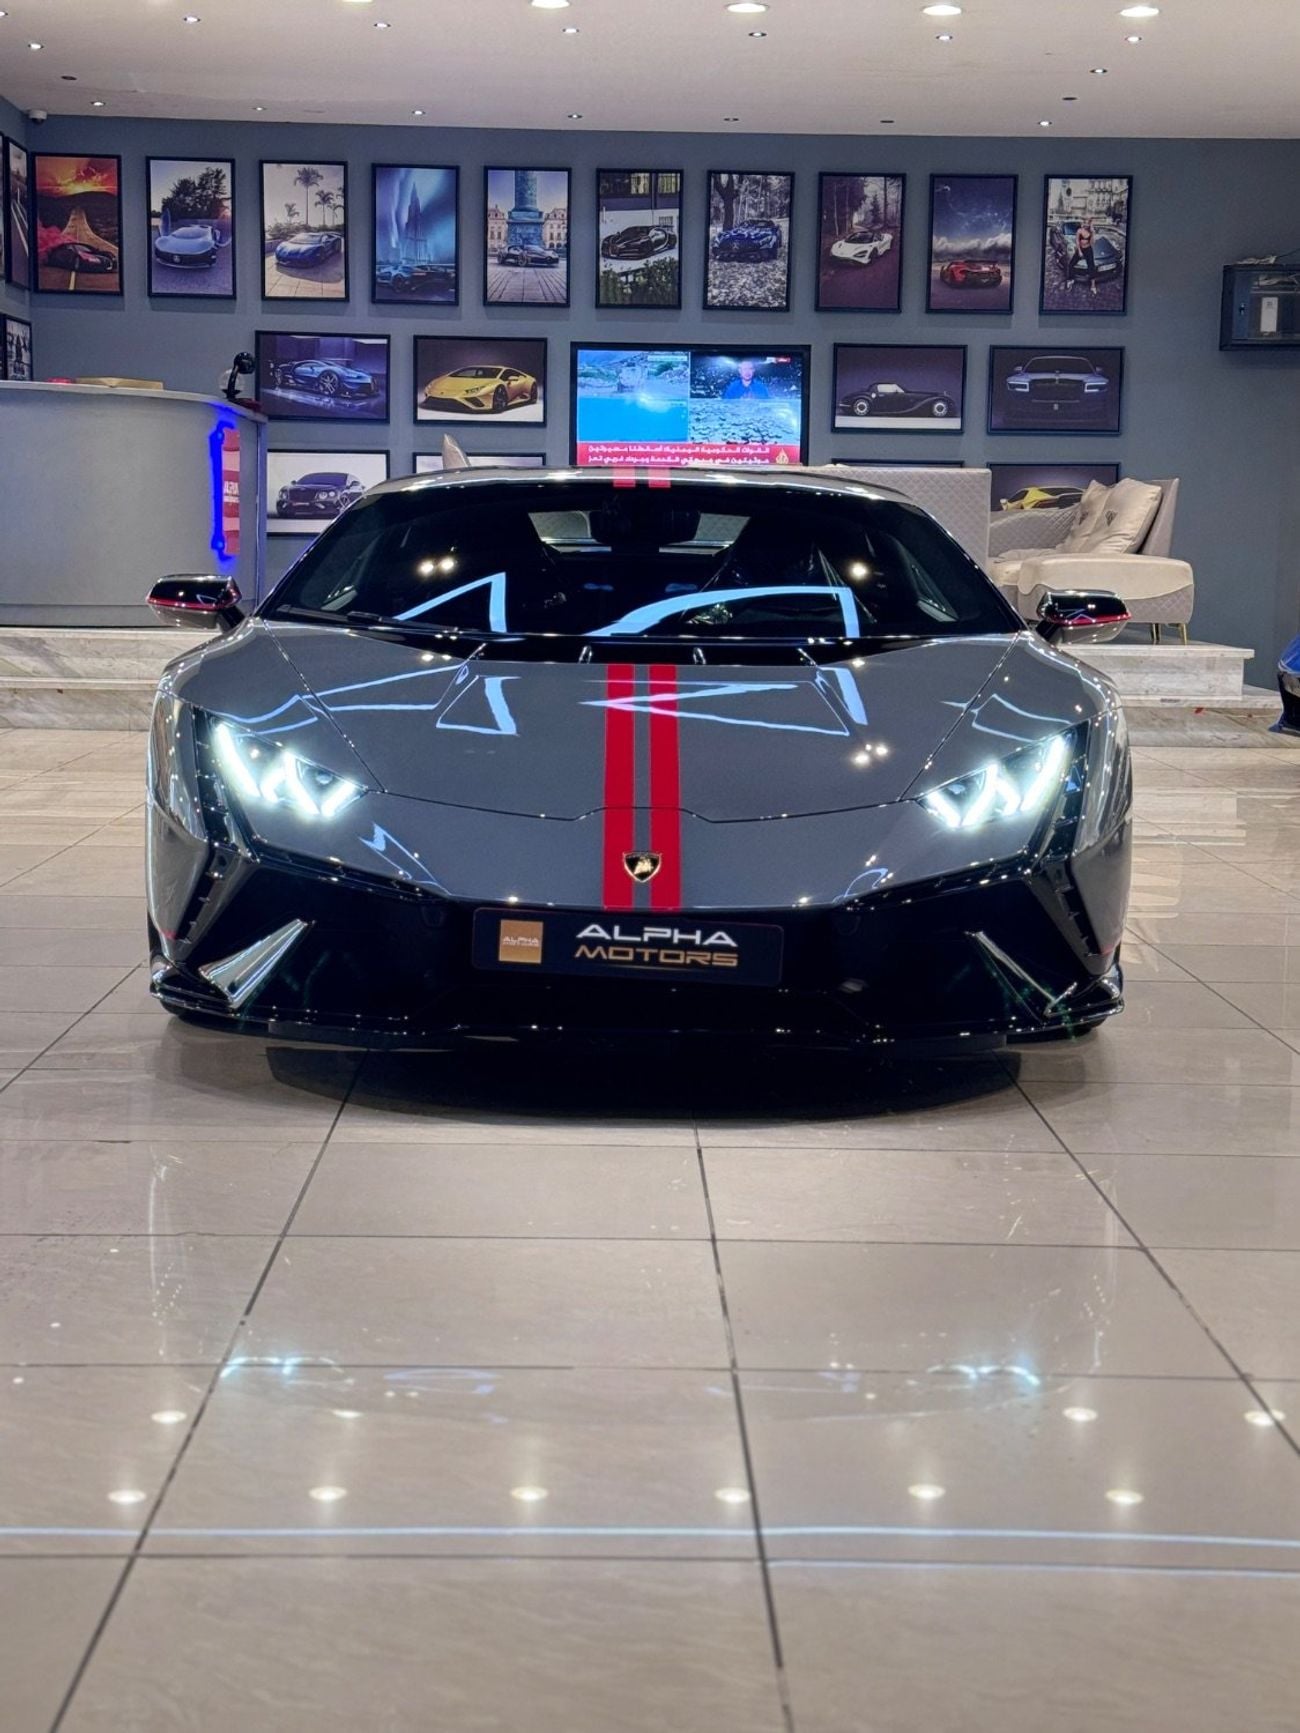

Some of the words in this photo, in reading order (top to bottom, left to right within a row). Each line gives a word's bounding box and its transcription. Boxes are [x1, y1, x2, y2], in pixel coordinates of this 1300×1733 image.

[588, 444, 628, 453] مسيرتين
[700, 446, 740, 455] الحكومية
[741, 446, 770, 455] القوات
[588, 455, 603, 463] تعز
[603, 455, 624, 464] غربي
[715, 457, 730, 465] في
[576, 924, 738, 947] ALPHA
[575, 944, 738, 967] MOTORS
